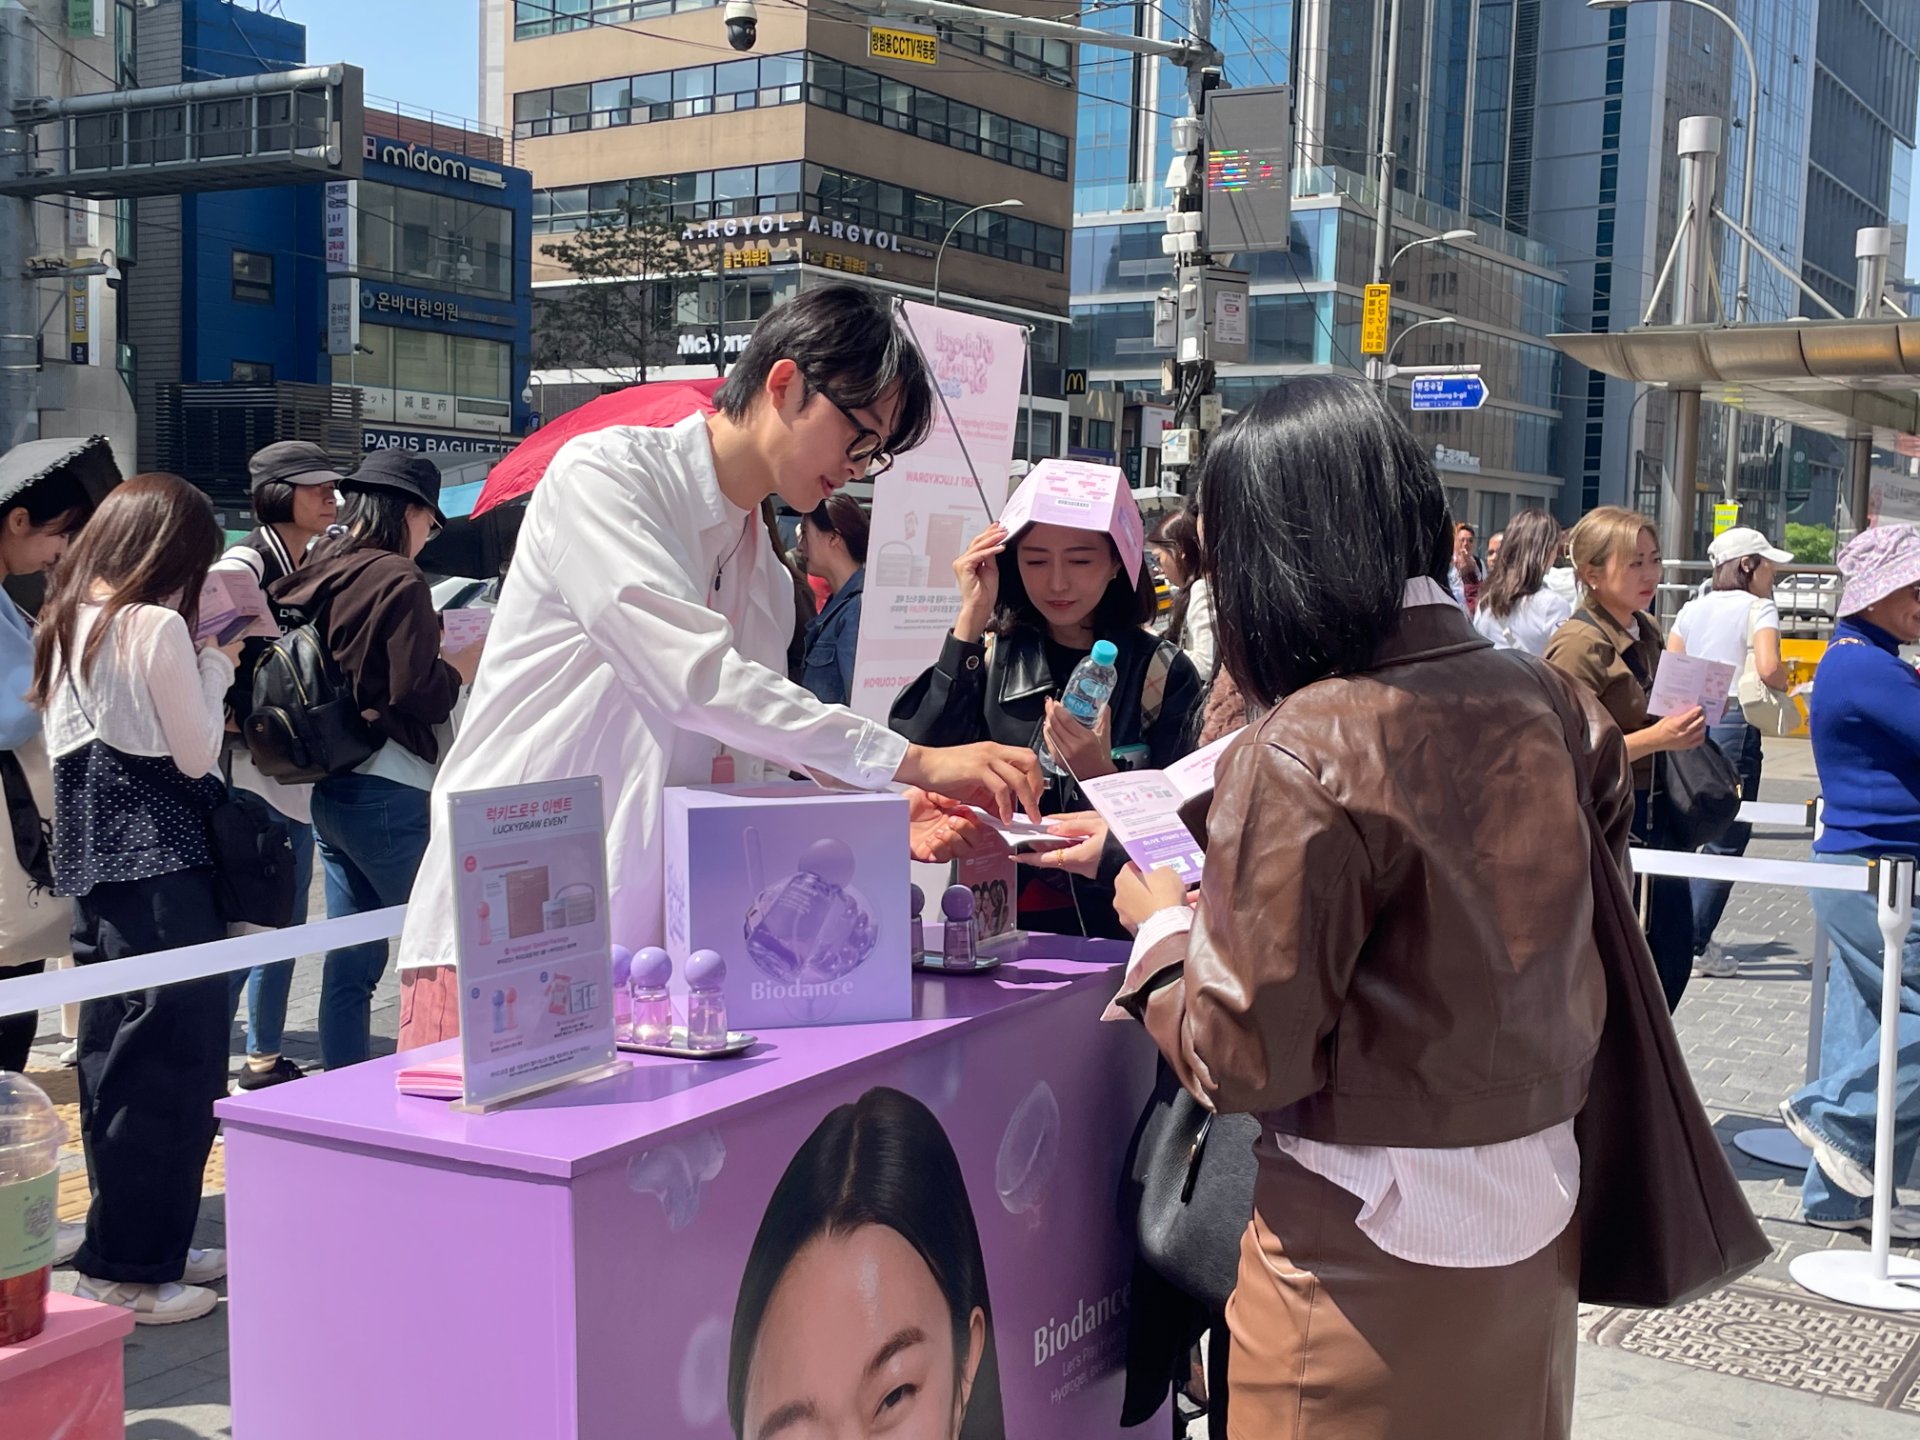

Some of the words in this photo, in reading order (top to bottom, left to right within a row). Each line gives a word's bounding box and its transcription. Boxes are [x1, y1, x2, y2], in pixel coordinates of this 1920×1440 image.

[872, 32, 936, 60] 방범용CCTV작동중
[383, 142, 467, 180] midam
[808, 215, 902, 252] A:RGYOL
[376, 292, 459, 322] 온바디한의원
[365, 433, 420, 453] PARIS
[486, 801, 540, 823] 럭키드로우
[542, 797, 574, 815] 이벤트
[492, 819, 542, 835] LUCKYDRAW
[543, 815, 568, 828] EVENT
[751, 979, 854, 1001] Biodance
